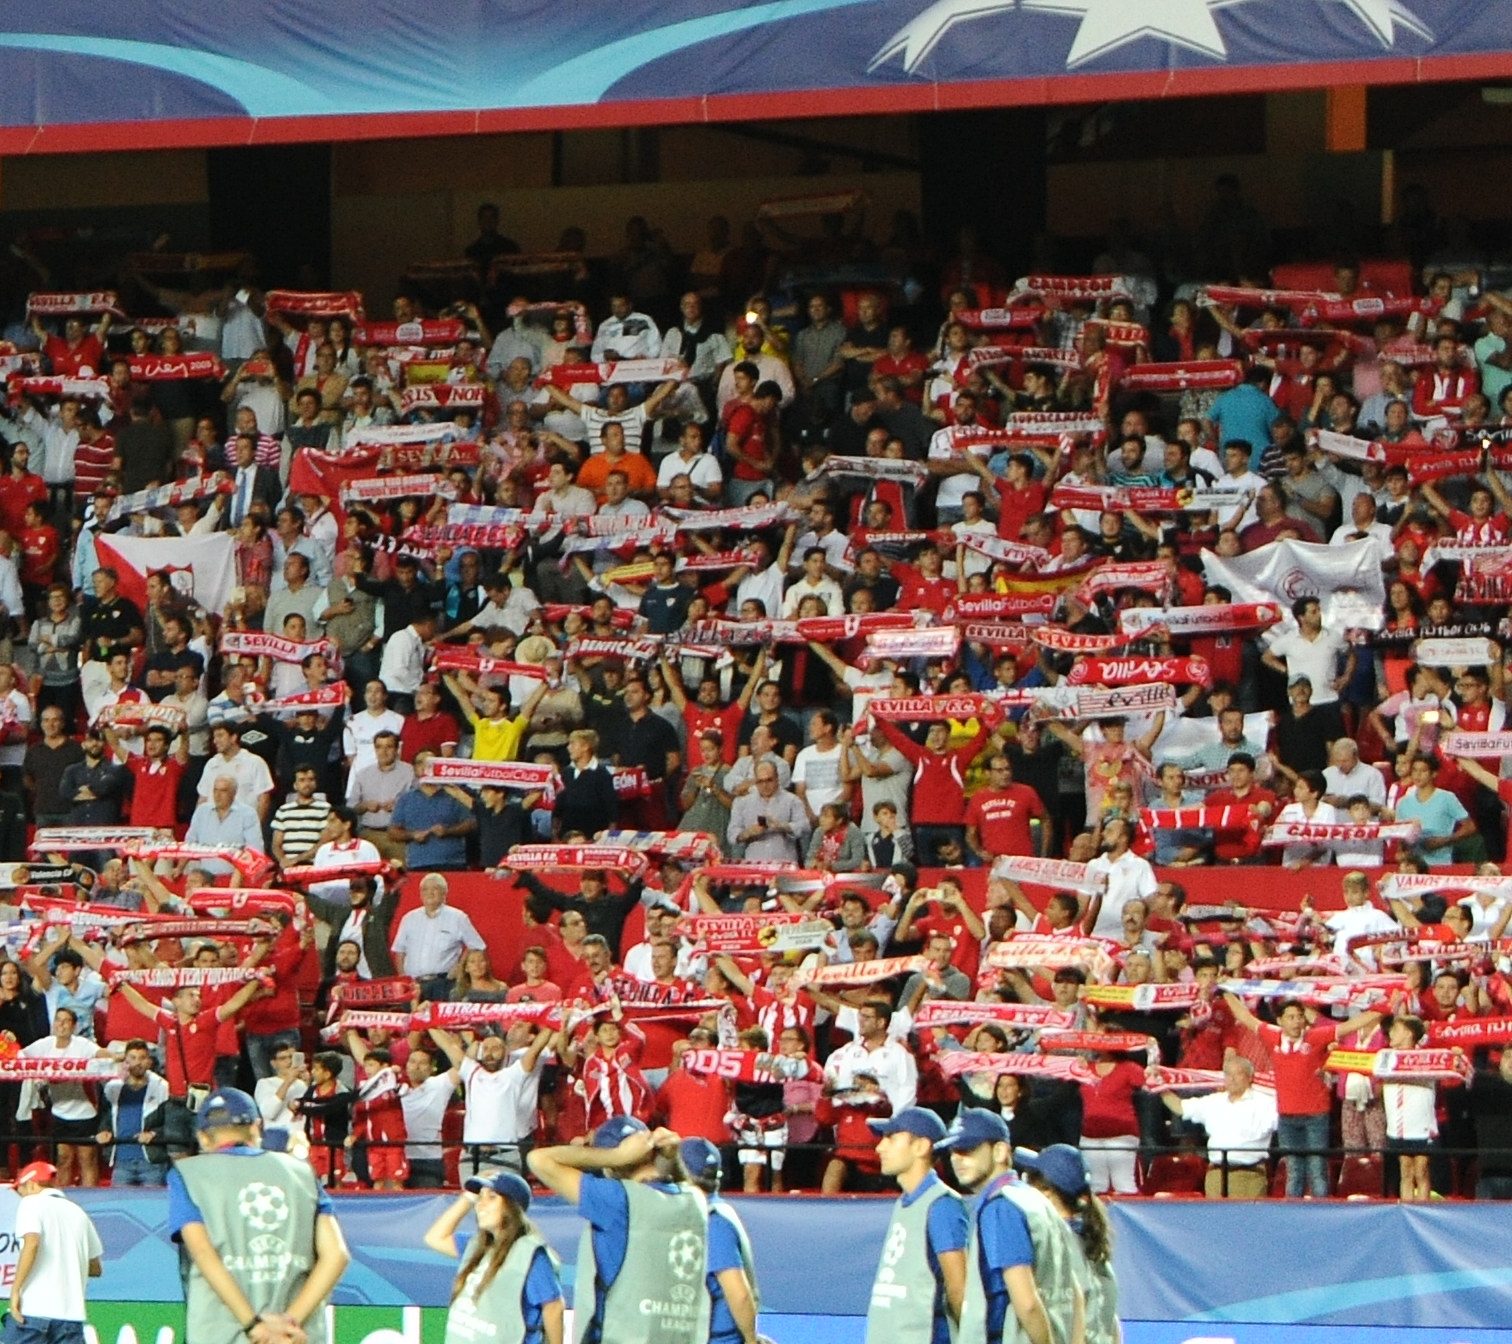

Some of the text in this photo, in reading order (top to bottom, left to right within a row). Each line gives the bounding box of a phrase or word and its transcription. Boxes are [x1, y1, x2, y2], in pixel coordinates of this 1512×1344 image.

[966, 624, 1025, 638] SEVILLA
[1035, 630, 1116, 649] SEVILLA
[243, 633, 297, 654] SEVILLA
[869, 698, 931, 713] SEVILLA
[695, 917, 752, 932] SEVILLA
[811, 962, 873, 983] Sevilla
